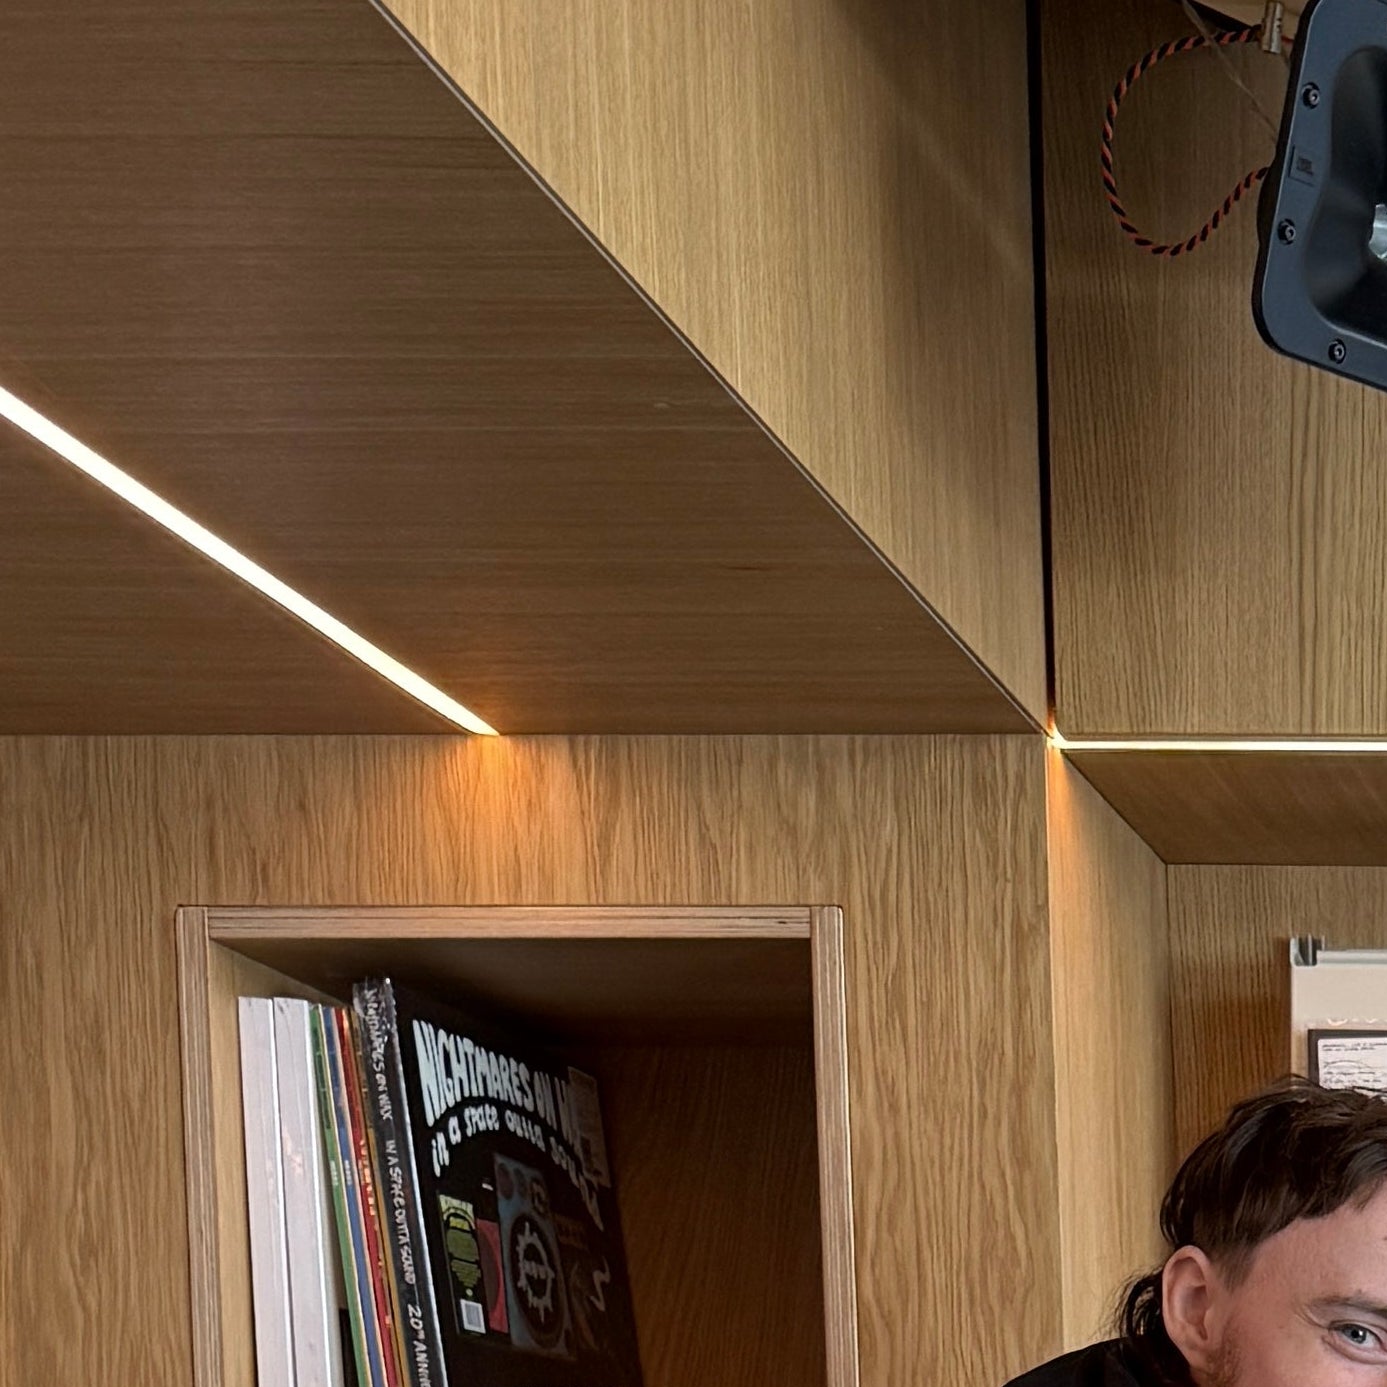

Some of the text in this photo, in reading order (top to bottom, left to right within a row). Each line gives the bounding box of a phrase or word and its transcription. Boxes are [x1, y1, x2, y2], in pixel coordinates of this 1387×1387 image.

[412, 1019, 535, 1128] NIGHTMARES
[533, 1070, 557, 1132] ON
[431, 1131, 450, 1178] in
[448, 1116, 462, 1146] a
[463, 1103, 500, 1138] space
[504, 1109, 546, 1153] outta
